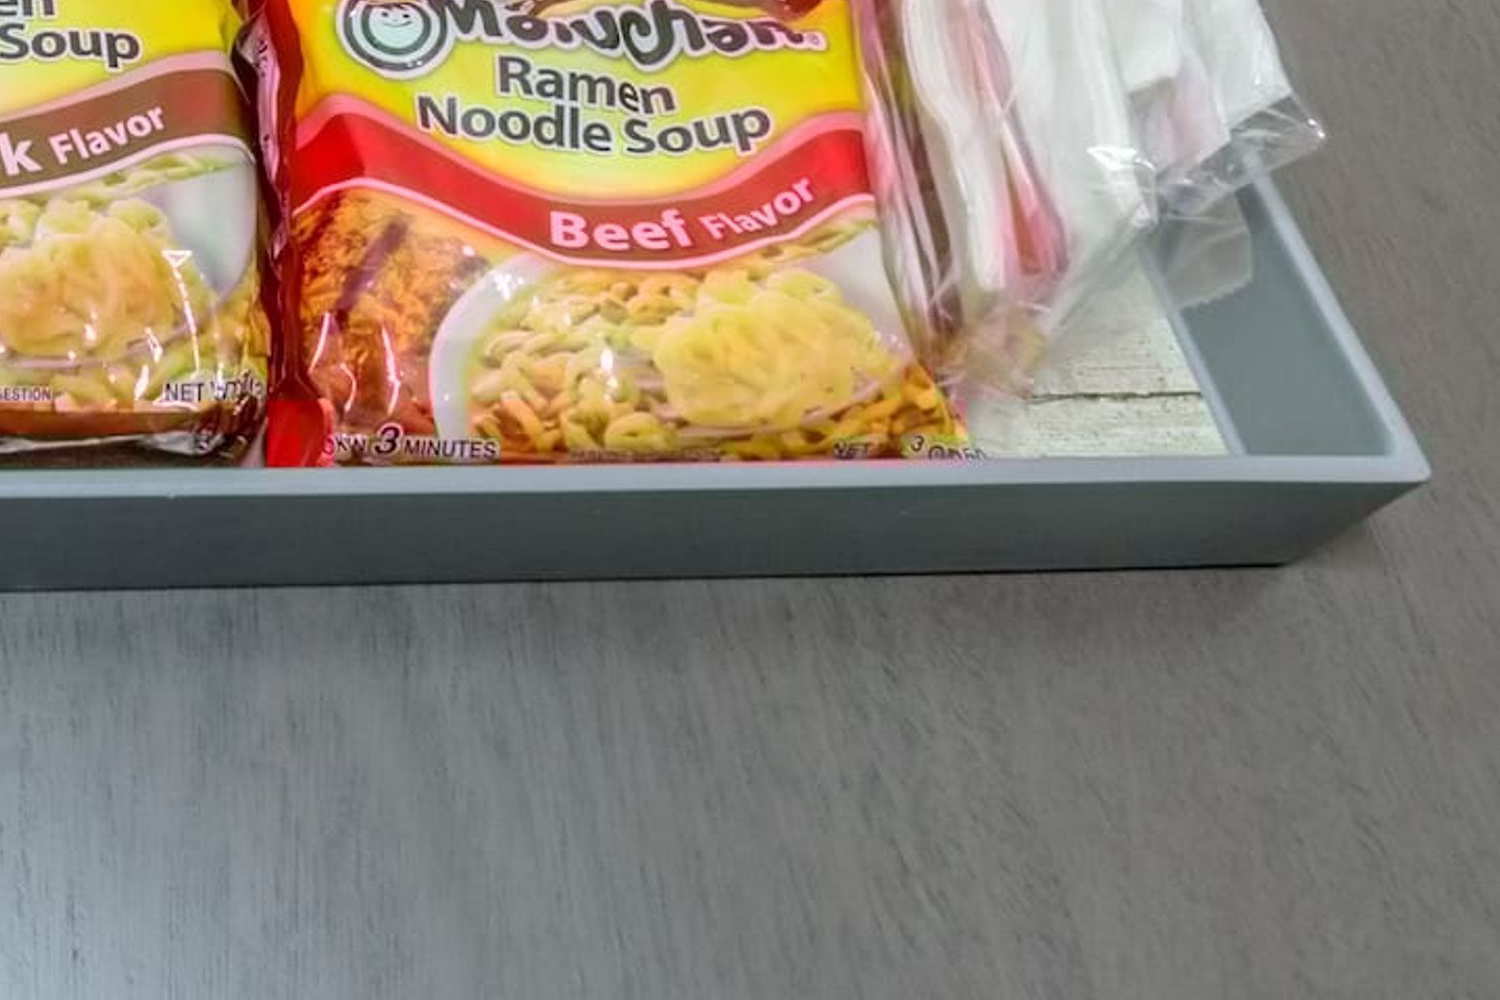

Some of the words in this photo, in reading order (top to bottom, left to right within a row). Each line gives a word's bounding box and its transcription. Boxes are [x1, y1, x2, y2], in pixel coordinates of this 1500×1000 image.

[498, 55, 676, 114] Ramen
[48, 105, 165, 165] Flavor
[417, 96, 612, 152] Noodle
[625, 109, 771, 153] Soup
[550, 208, 693, 250] Beef
[698, 177, 814, 240] Flavor
[164, 383, 203, 402] NET
[374, 426, 399, 455] 3
[403, 438, 498, 459] MINUTES
